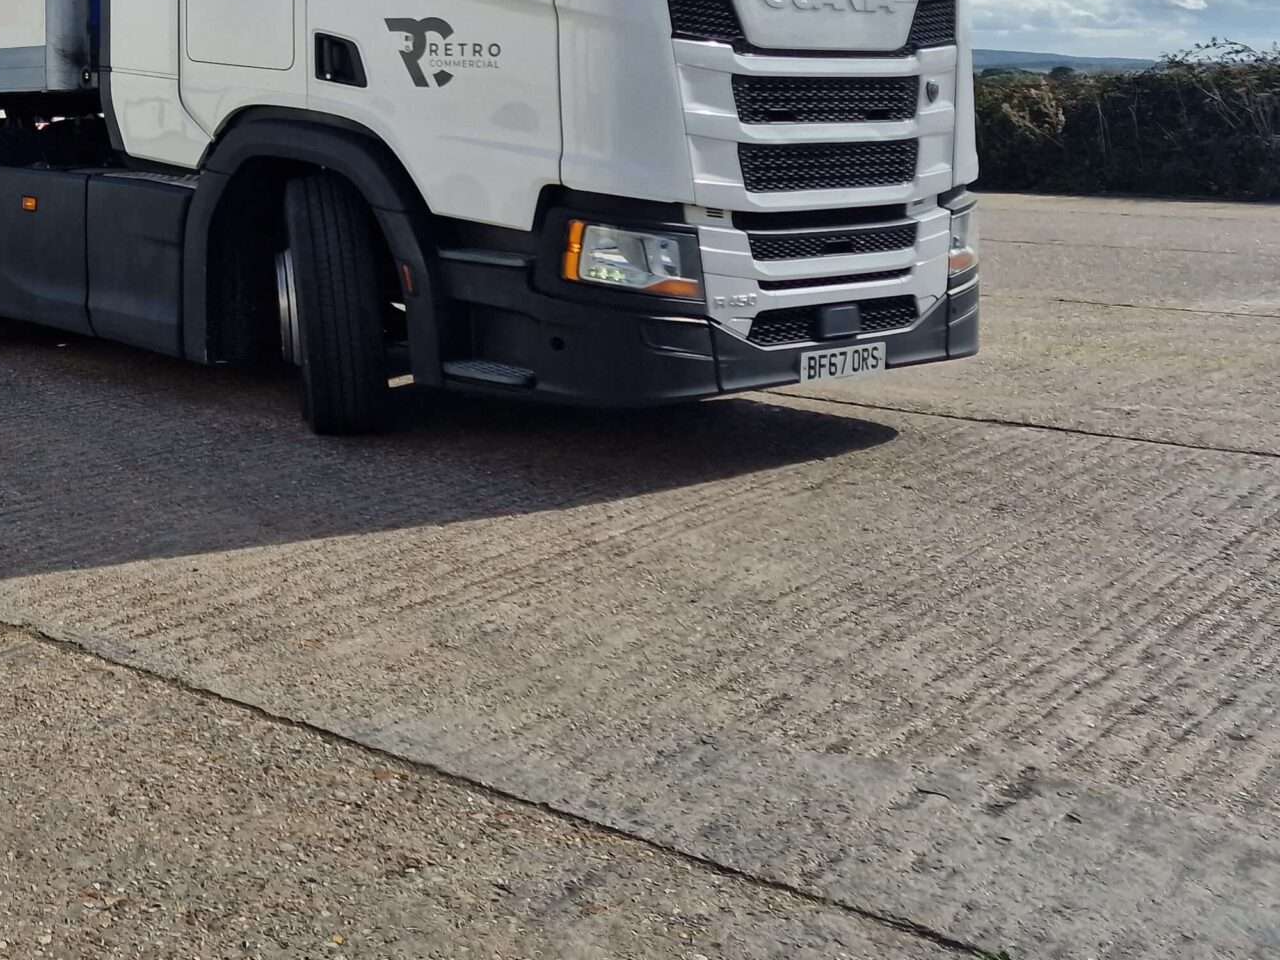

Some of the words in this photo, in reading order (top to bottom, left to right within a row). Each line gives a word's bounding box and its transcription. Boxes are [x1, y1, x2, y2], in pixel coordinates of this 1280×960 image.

[429, 43, 501, 57] RETRO
[429, 59, 500, 69] COMMERCIAL
[807, 351, 848, 380] BF67
